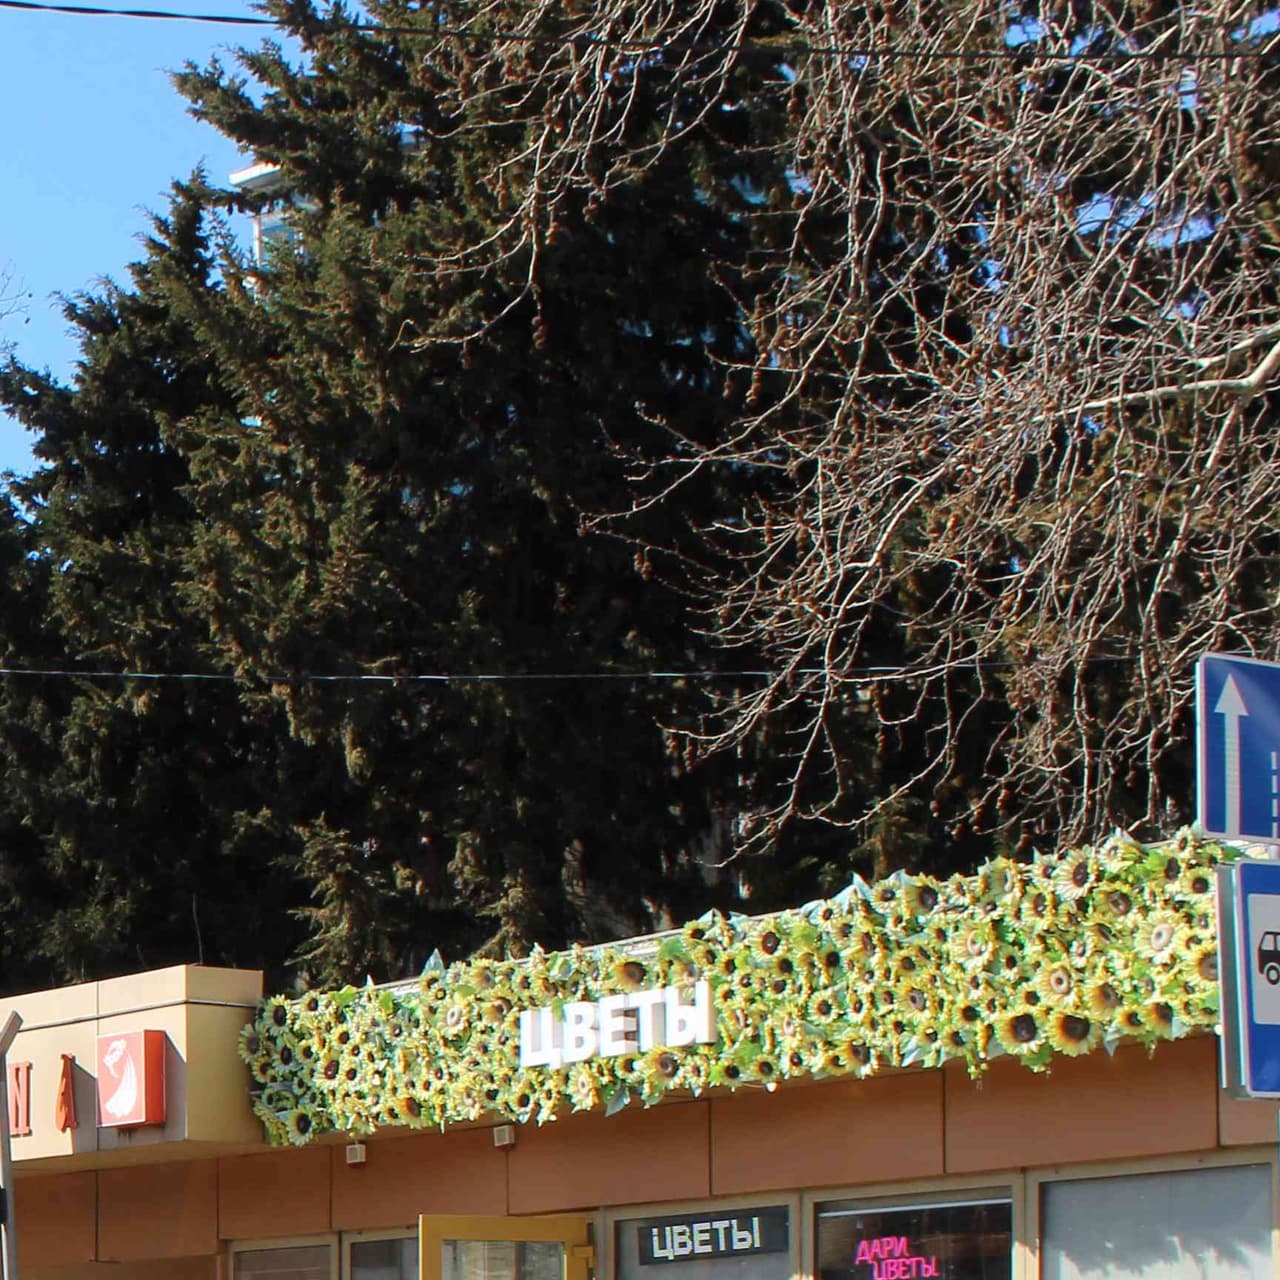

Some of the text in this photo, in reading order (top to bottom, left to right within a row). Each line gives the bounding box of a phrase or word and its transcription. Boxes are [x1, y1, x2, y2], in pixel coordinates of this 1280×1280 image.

[520, 981, 718, 1069] ЦВЕТЫ
[651, 1216, 761, 1261] ЦВЕТЫ
[855, 1236, 910, 1265] ДАРИ
